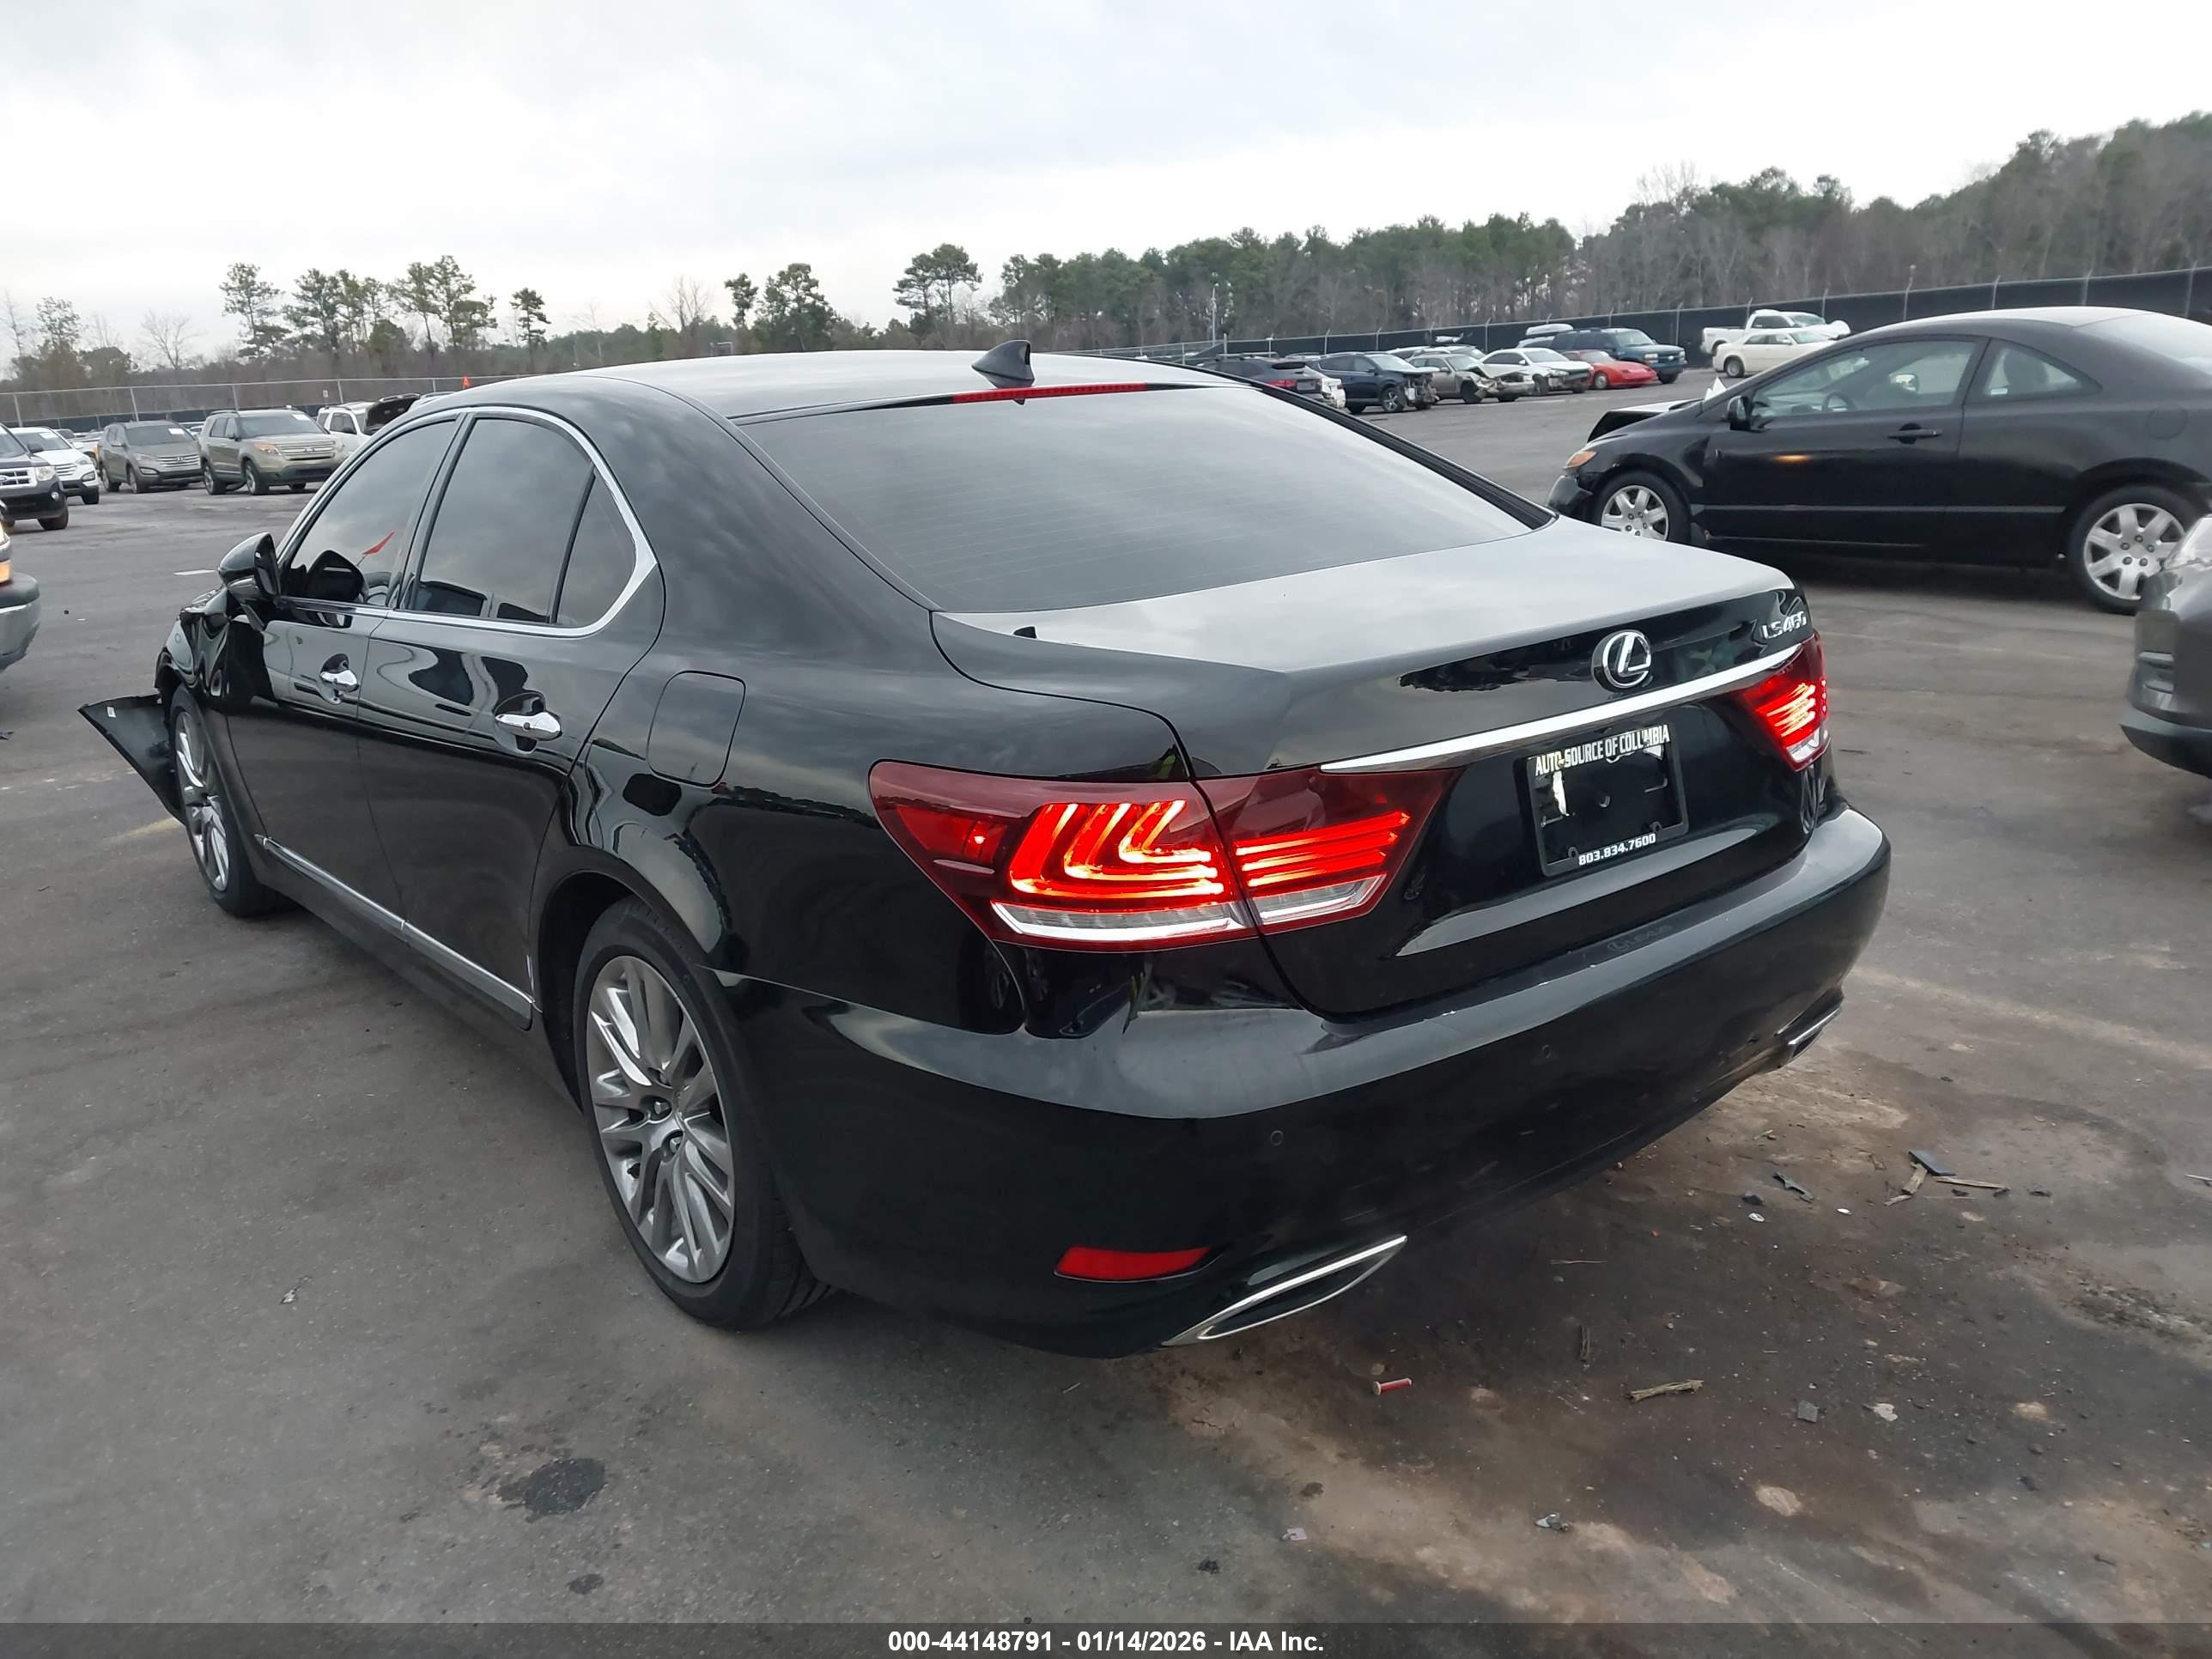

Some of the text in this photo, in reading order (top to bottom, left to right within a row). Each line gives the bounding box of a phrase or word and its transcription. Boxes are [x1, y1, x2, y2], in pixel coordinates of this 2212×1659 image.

[1534, 750, 1563, 777] AUTO
[1563, 739, 1605, 769] SOURCE
[1604, 738, 1619, 758] OF
[1578, 832, 1657, 866] 803.834.7600
